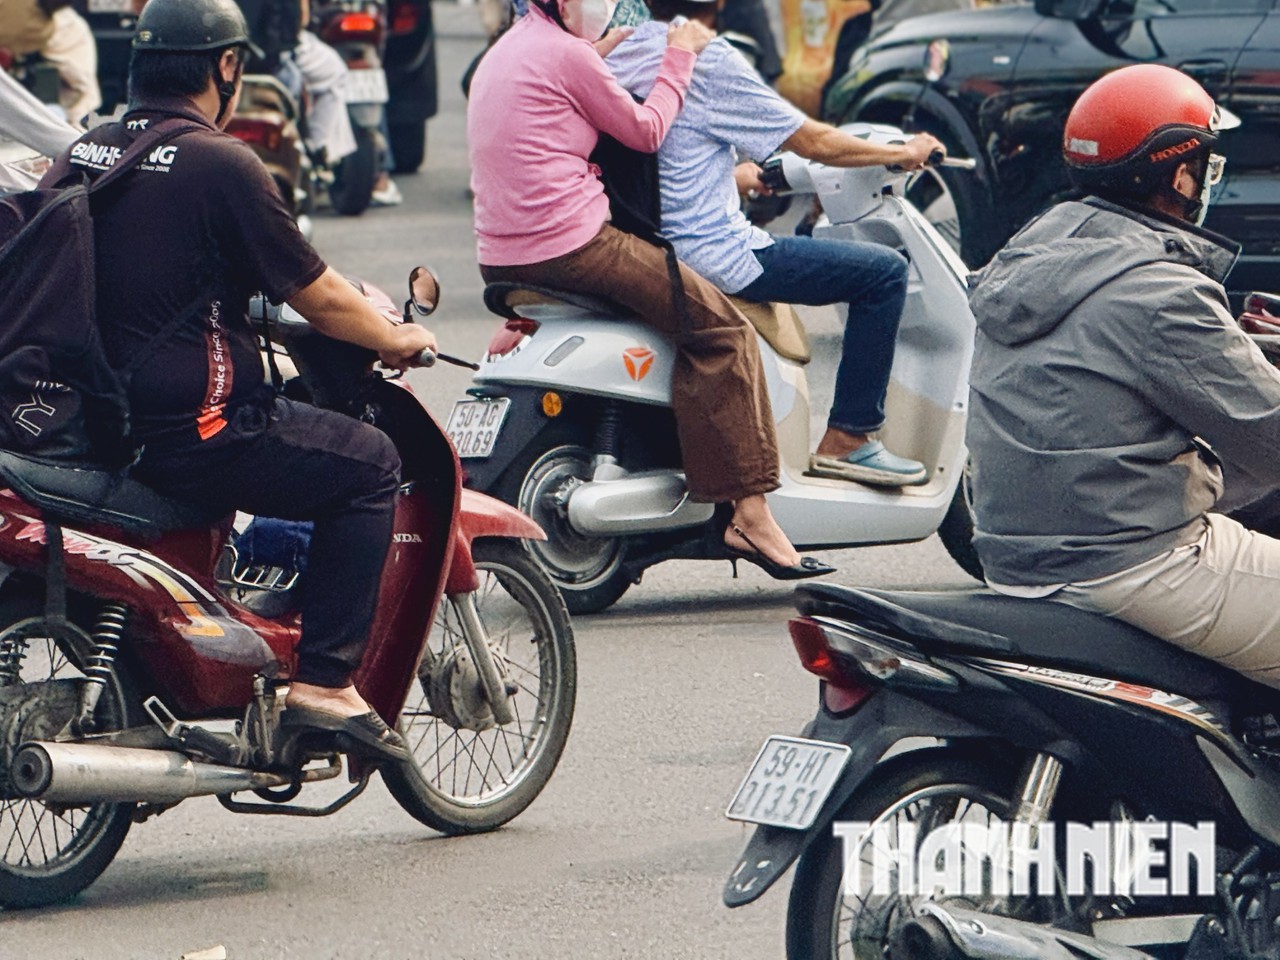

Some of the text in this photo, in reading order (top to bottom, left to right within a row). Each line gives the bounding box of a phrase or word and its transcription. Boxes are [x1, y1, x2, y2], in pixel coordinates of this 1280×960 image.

[1150, 138, 1200, 162] HONDA
[212, 331, 224, 362] Since
[210, 364, 226, 404] Choice
[764, 745, 832, 785] 59-H1
